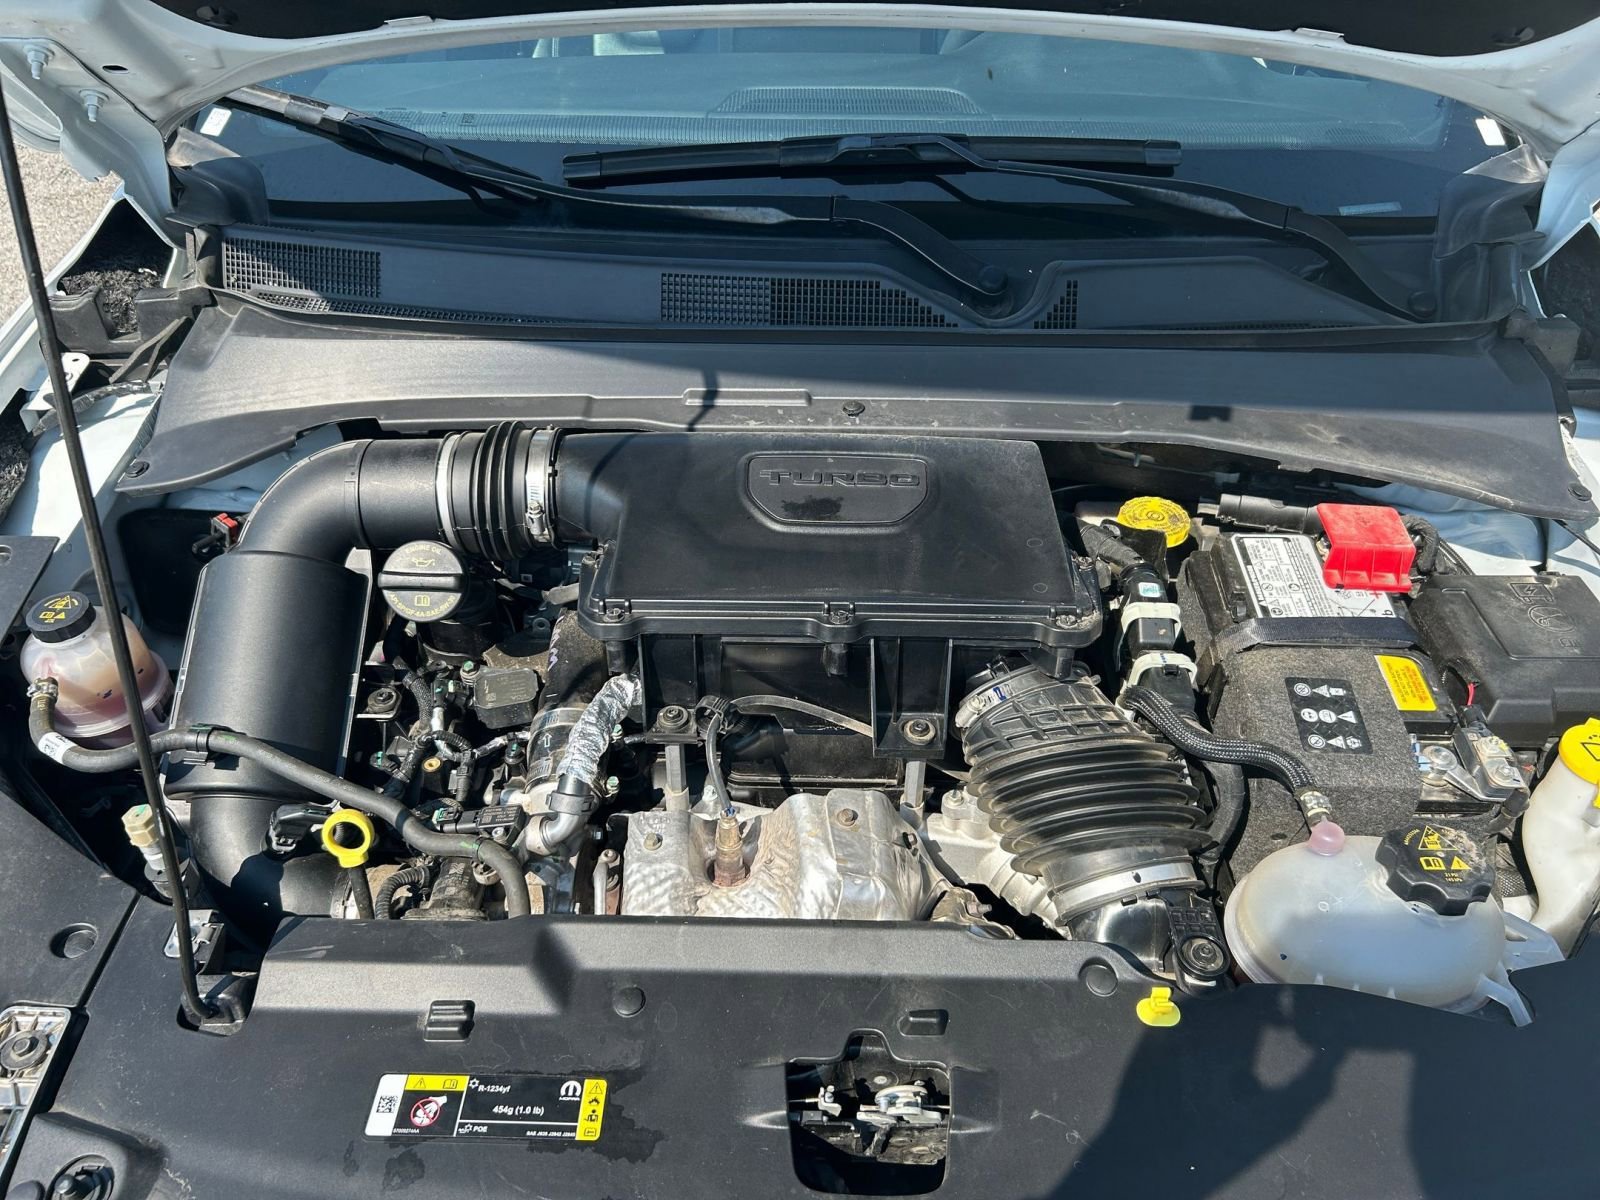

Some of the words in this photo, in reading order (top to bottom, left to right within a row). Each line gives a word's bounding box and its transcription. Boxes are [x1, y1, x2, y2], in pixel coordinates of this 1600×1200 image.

[760, 469, 920, 487] TURBO
[405, 544, 431, 554] ENGINE
[478, 1084, 511, 1094] R-1234yf
[492, 1105, 514, 1116] 454g
[515, 1105, 532, 1116] (1.0
[532, 1106, 545, 1116] lb)
[472, 1125, 488, 1133] POE
